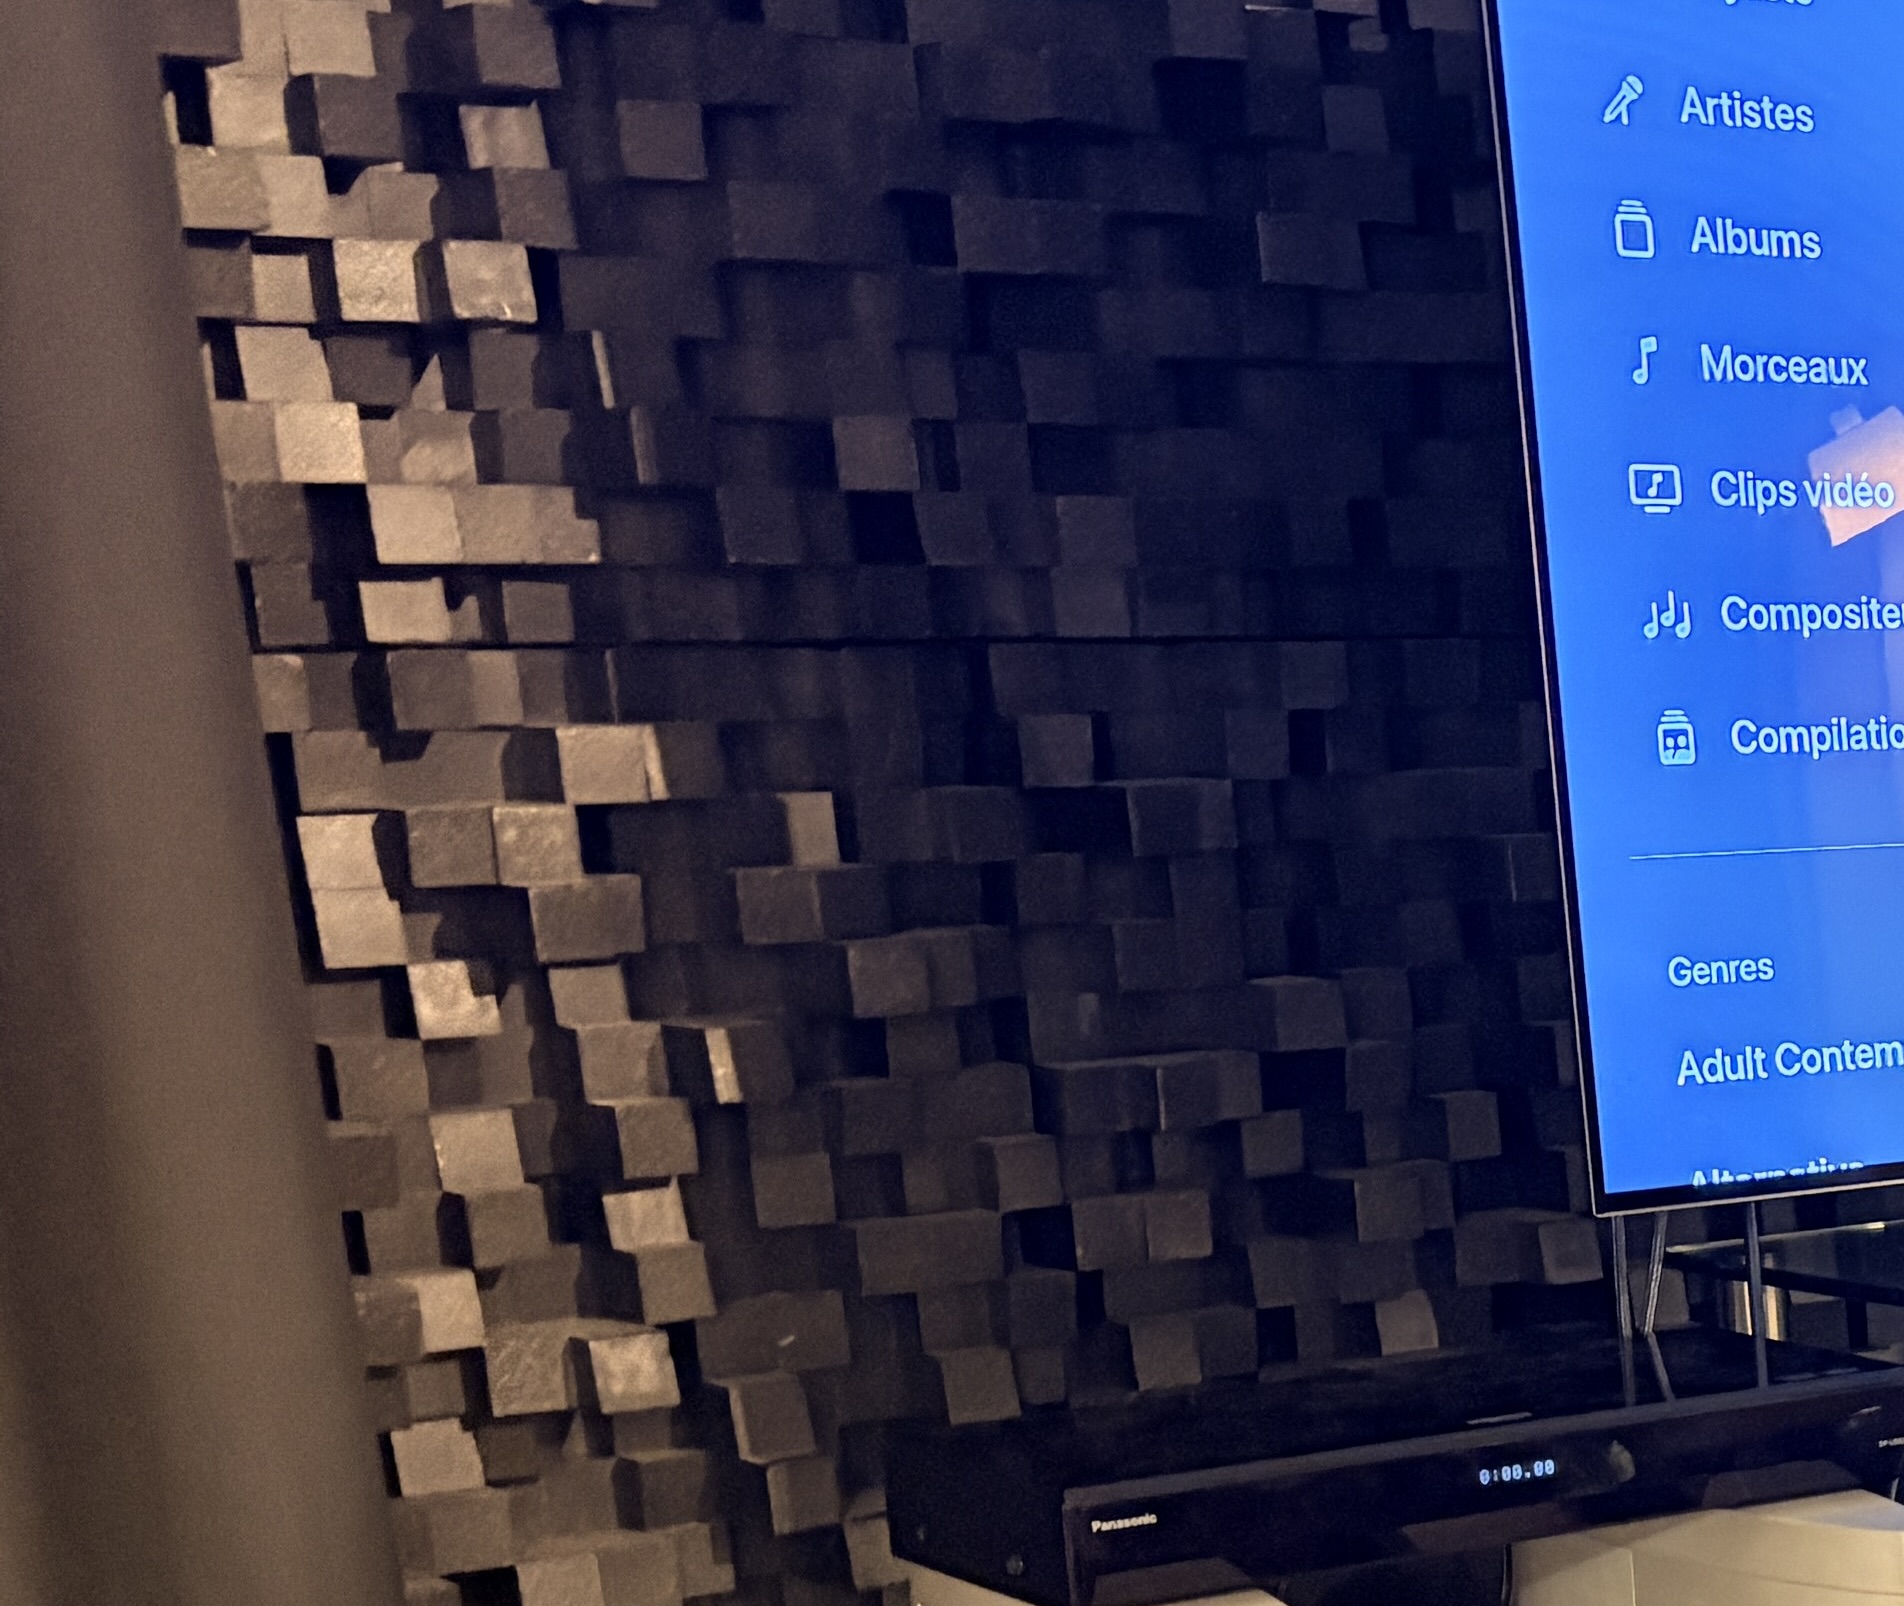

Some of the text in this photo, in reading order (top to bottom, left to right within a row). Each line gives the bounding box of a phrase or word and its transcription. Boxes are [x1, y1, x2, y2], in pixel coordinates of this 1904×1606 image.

[1680, 86, 1815, 132] Artistes
[1691, 216, 1821, 259] Albums
[1700, 343, 1869, 385] Morceaux
[1711, 470, 1895, 515] Clips vidéo
[1668, 954, 1775, 987] Genres
[1677, 1045, 1769, 1086] Adult
[1091, 1512, 1158, 1533] Panasonic
